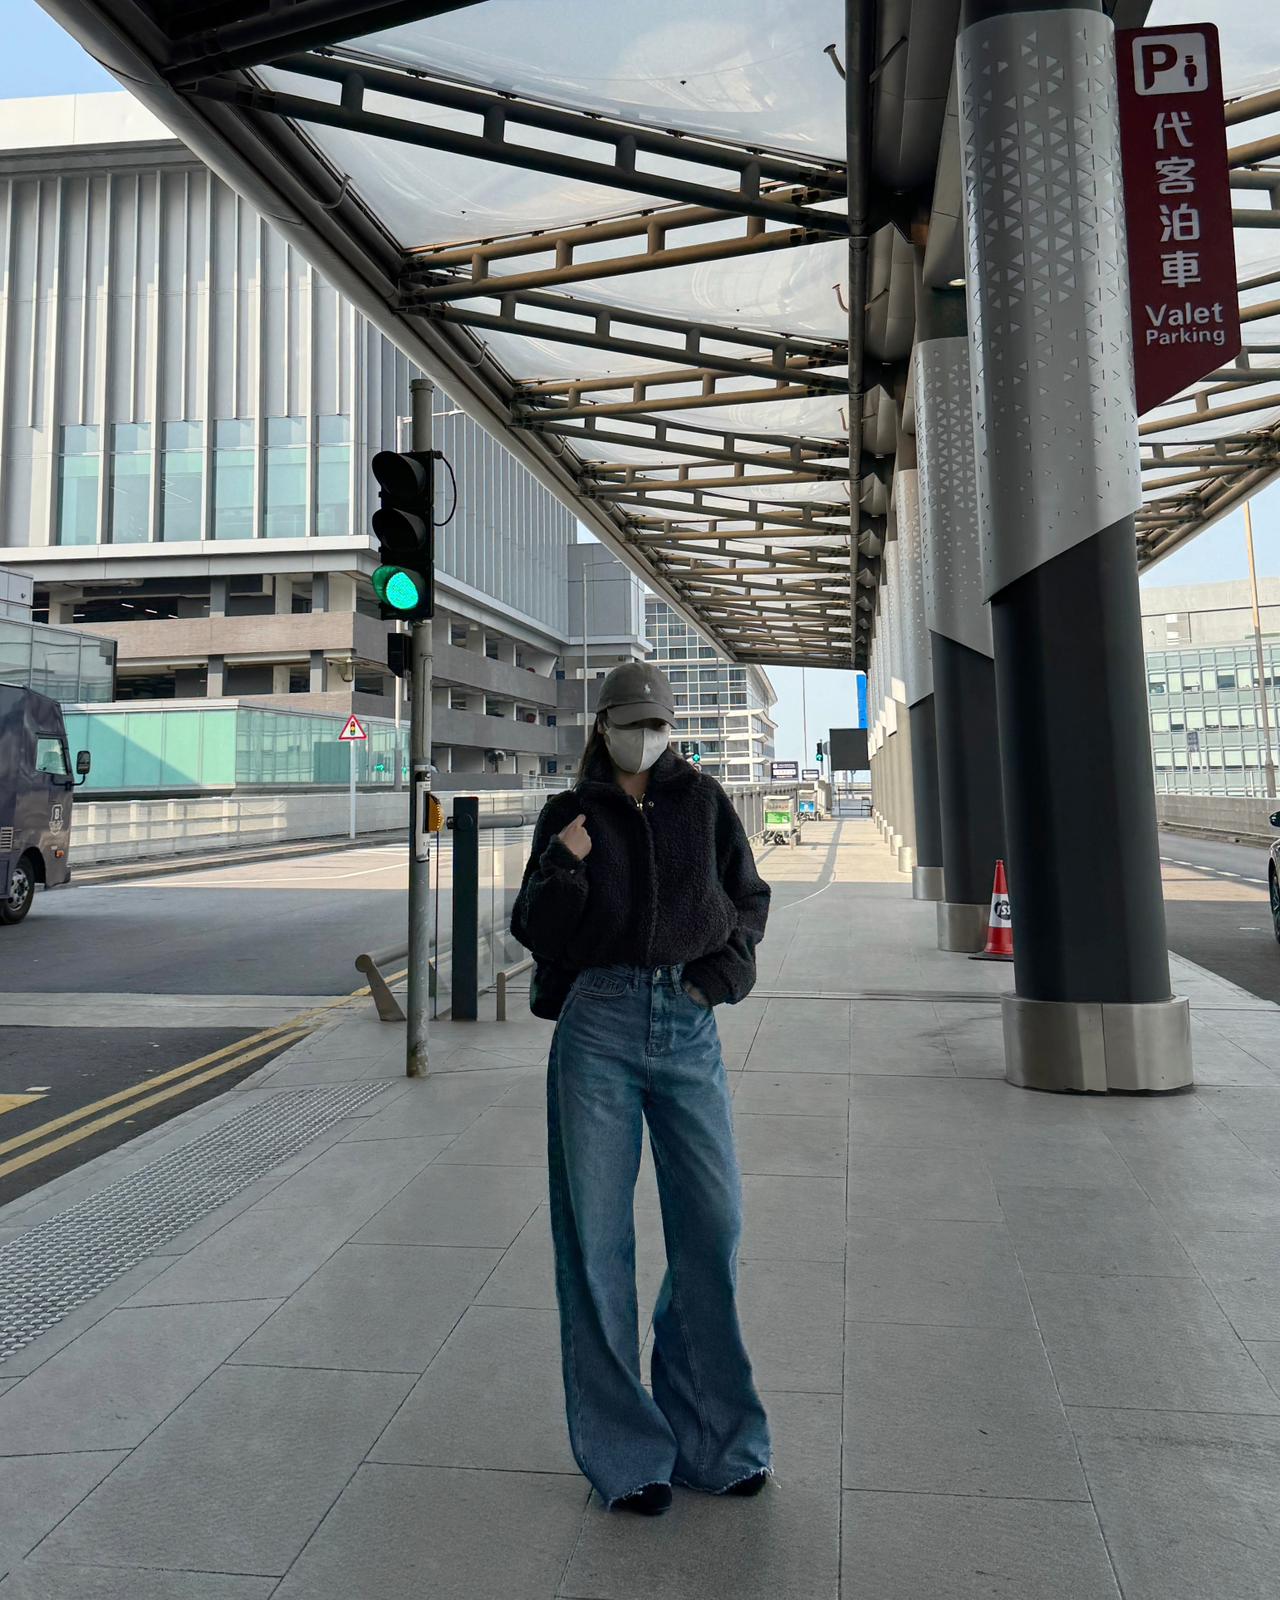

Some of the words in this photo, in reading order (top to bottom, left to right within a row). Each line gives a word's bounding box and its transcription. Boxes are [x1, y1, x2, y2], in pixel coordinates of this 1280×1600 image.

[1141, 44, 1178, 90] P
[1153, 111, 1201, 288] 代客泊車
[1145, 302, 1223, 327] Valet
[1146, 327, 1225, 346] Parking
